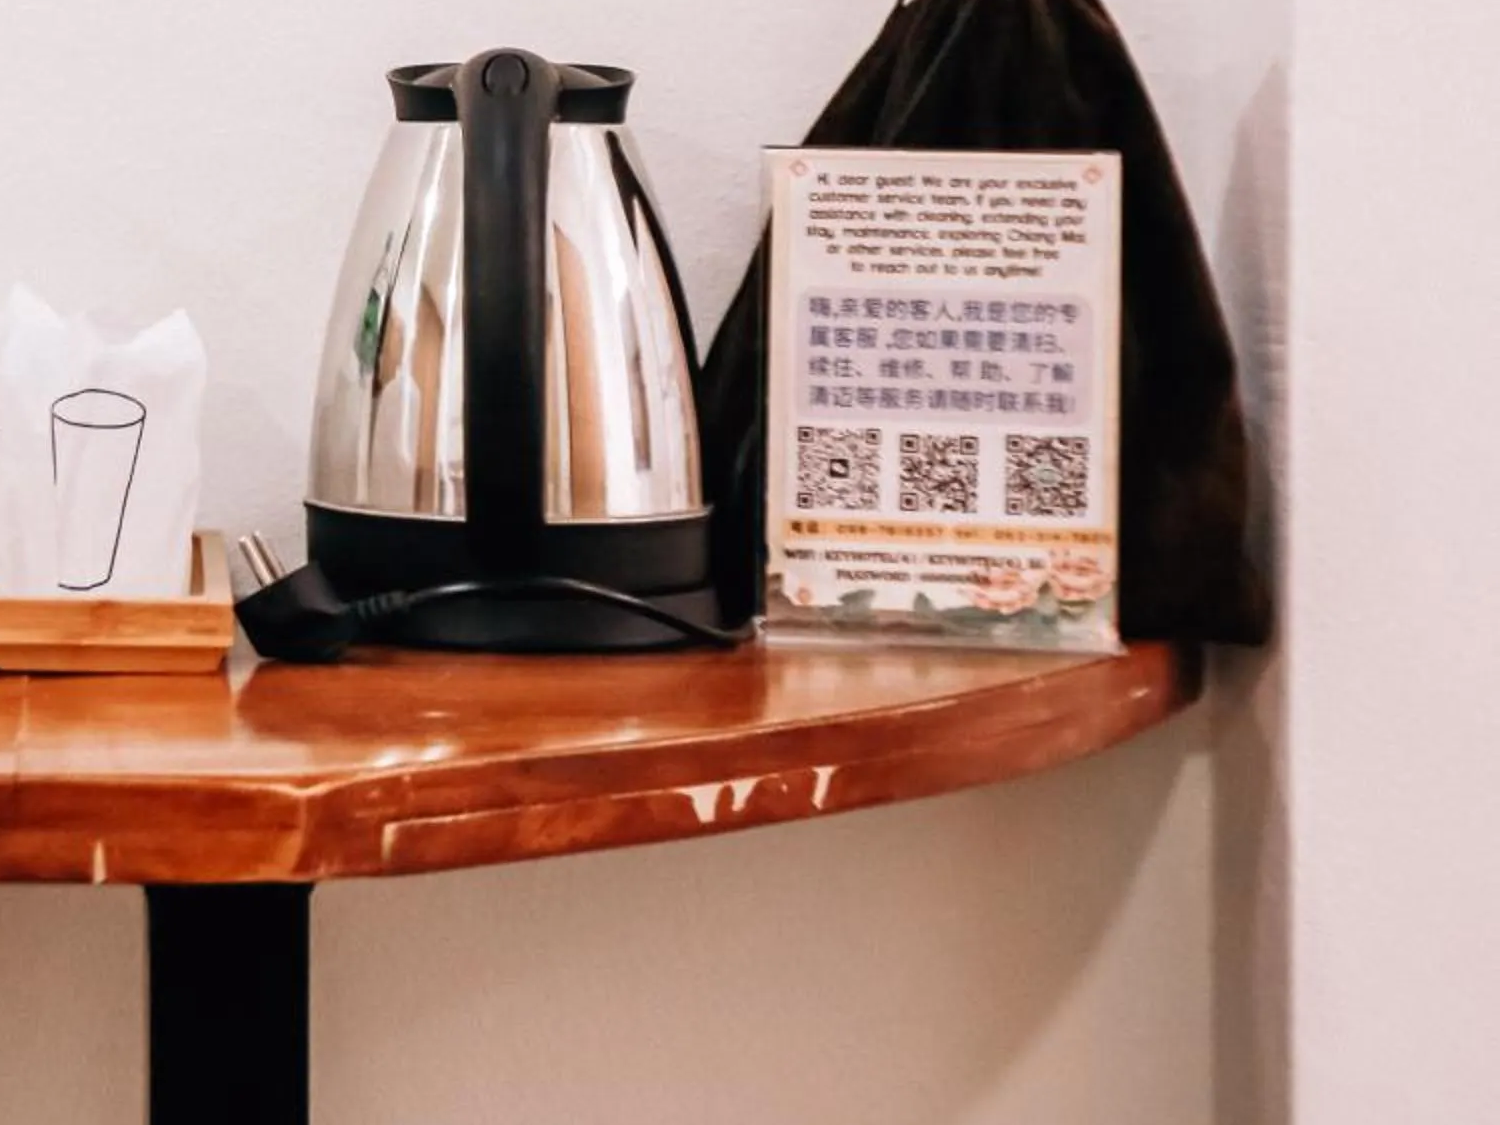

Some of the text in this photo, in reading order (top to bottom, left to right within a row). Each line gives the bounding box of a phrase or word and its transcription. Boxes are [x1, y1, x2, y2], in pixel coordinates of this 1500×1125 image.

[949, 177, 971, 188] are
[978, 178, 1008, 190] your
[809, 192, 870, 203] customer
[877, 193, 923, 204] service
[809, 209, 875, 221] assistance
[883, 208, 910, 221] with
[981, 212, 1049, 227] extending
[1054, 214, 1085, 228] your
[1007, 229, 1057, 245] Chiang
[826, 244, 840, 255] or
[846, 243, 882, 256] other
[952, 246, 996, 260] please
[851, 261, 864, 273] to
[870, 261, 909, 274] reach
[915, 262, 937, 274] out
[943, 263, 957, 275] to
[963, 265, 978, 275] us
